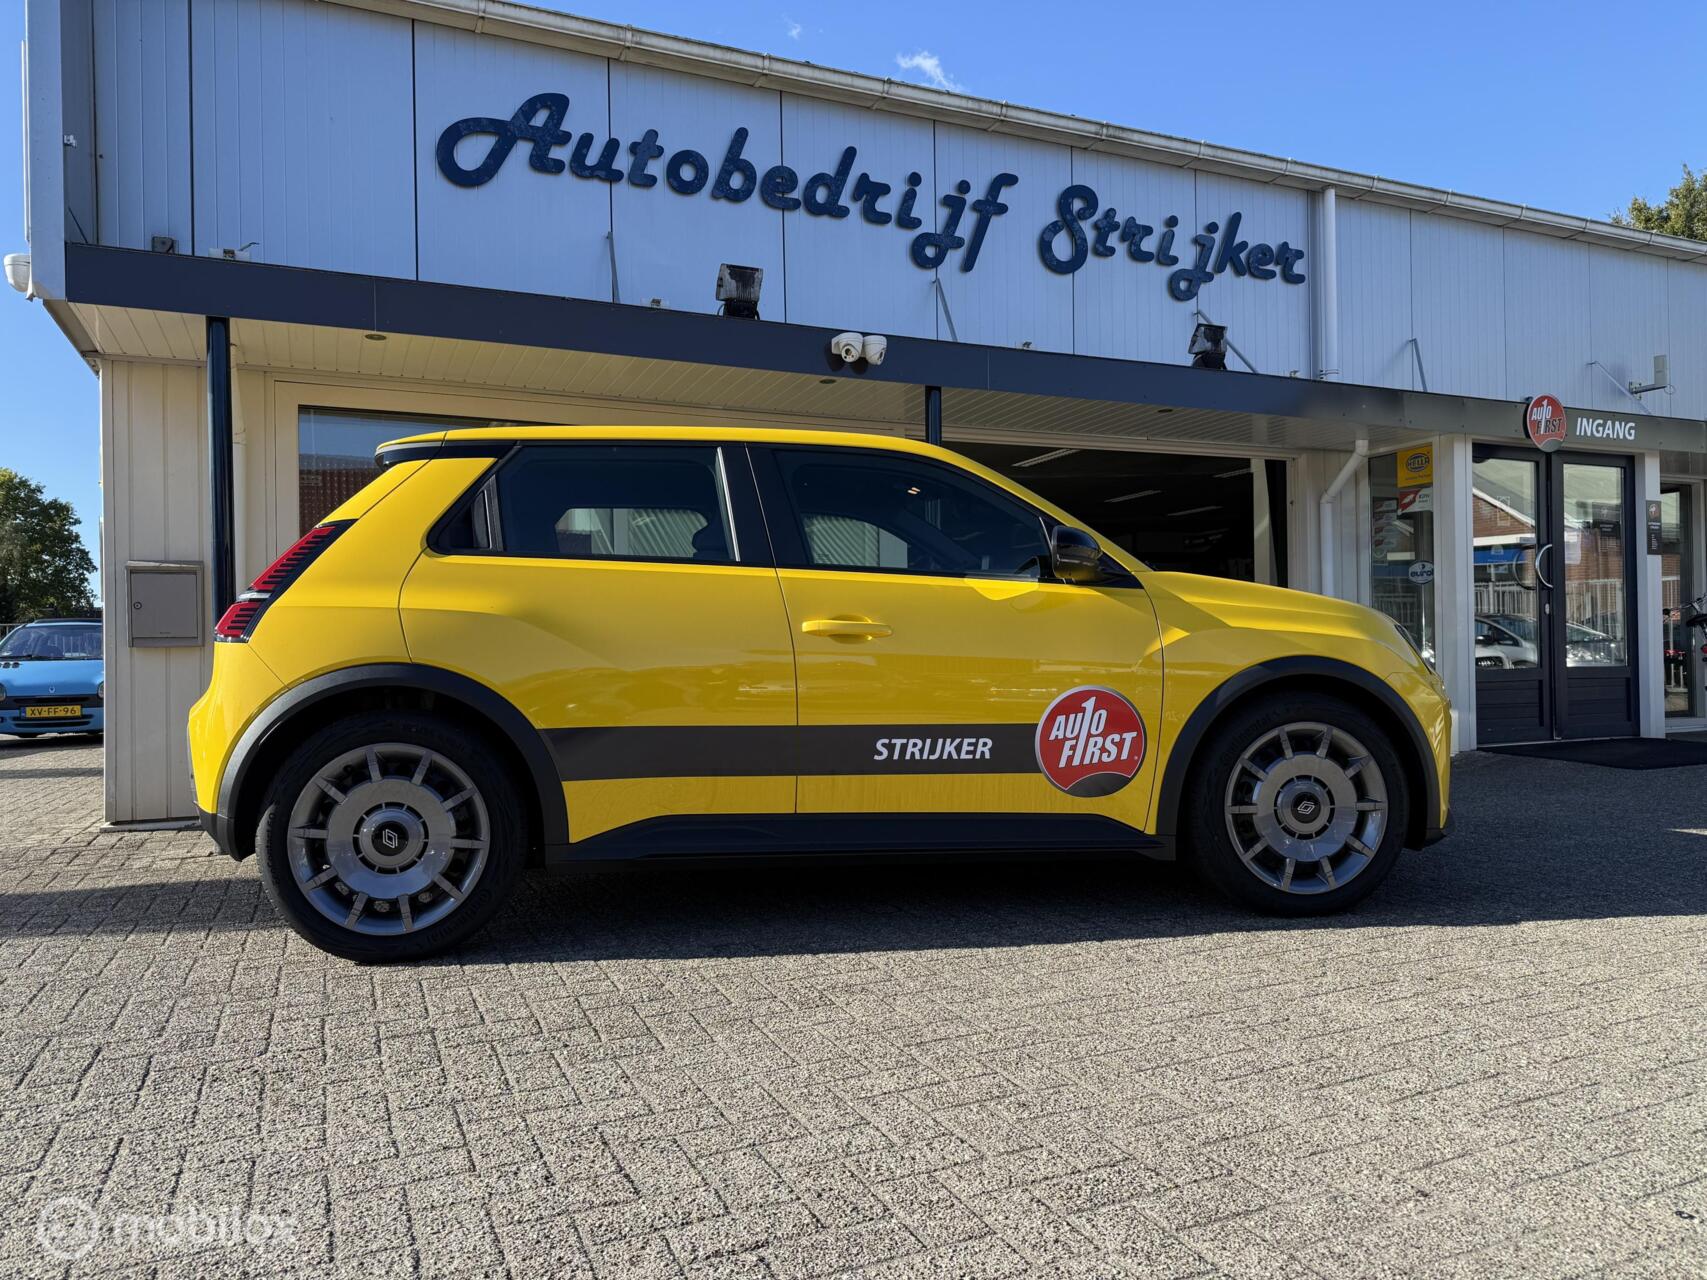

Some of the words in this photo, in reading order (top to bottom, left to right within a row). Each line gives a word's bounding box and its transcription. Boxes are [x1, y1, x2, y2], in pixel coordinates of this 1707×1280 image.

[436, 92, 1018, 272] Autobedrijf
[1040, 184, 1306, 300] Strijker
[1576, 417, 1636, 440] INGANG
[873, 737, 993, 761] STRIJKER
[1058, 731, 1138, 769] FIRST
